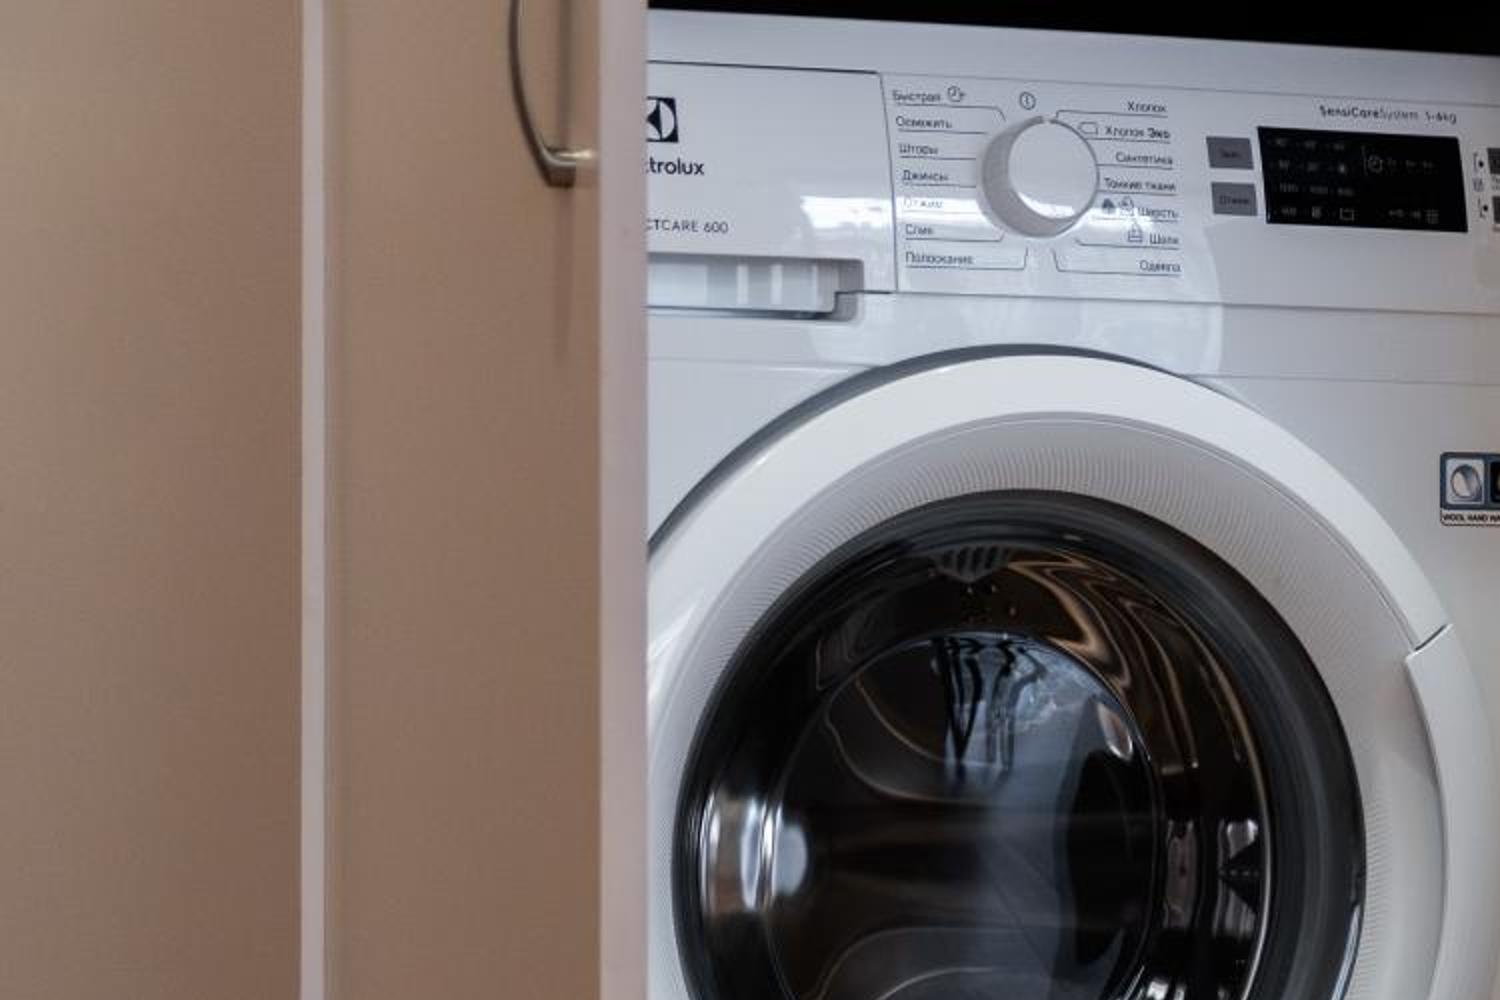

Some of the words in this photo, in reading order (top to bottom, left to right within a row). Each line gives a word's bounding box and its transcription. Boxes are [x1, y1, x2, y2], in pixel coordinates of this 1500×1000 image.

[1126, 101, 1168, 113] Хлопок
[895, 115, 953, 129] Освежить
[1104, 126, 1145, 138] Хлопок
[898, 143, 939, 156] Шторы
[1115, 152, 1174, 165] Синтетика
[646, 156, 705, 175] trolux
[901, 169, 949, 183] Джинсы
[703, 221, 729, 234] 600
[905, 251, 974, 265] Полоскание
